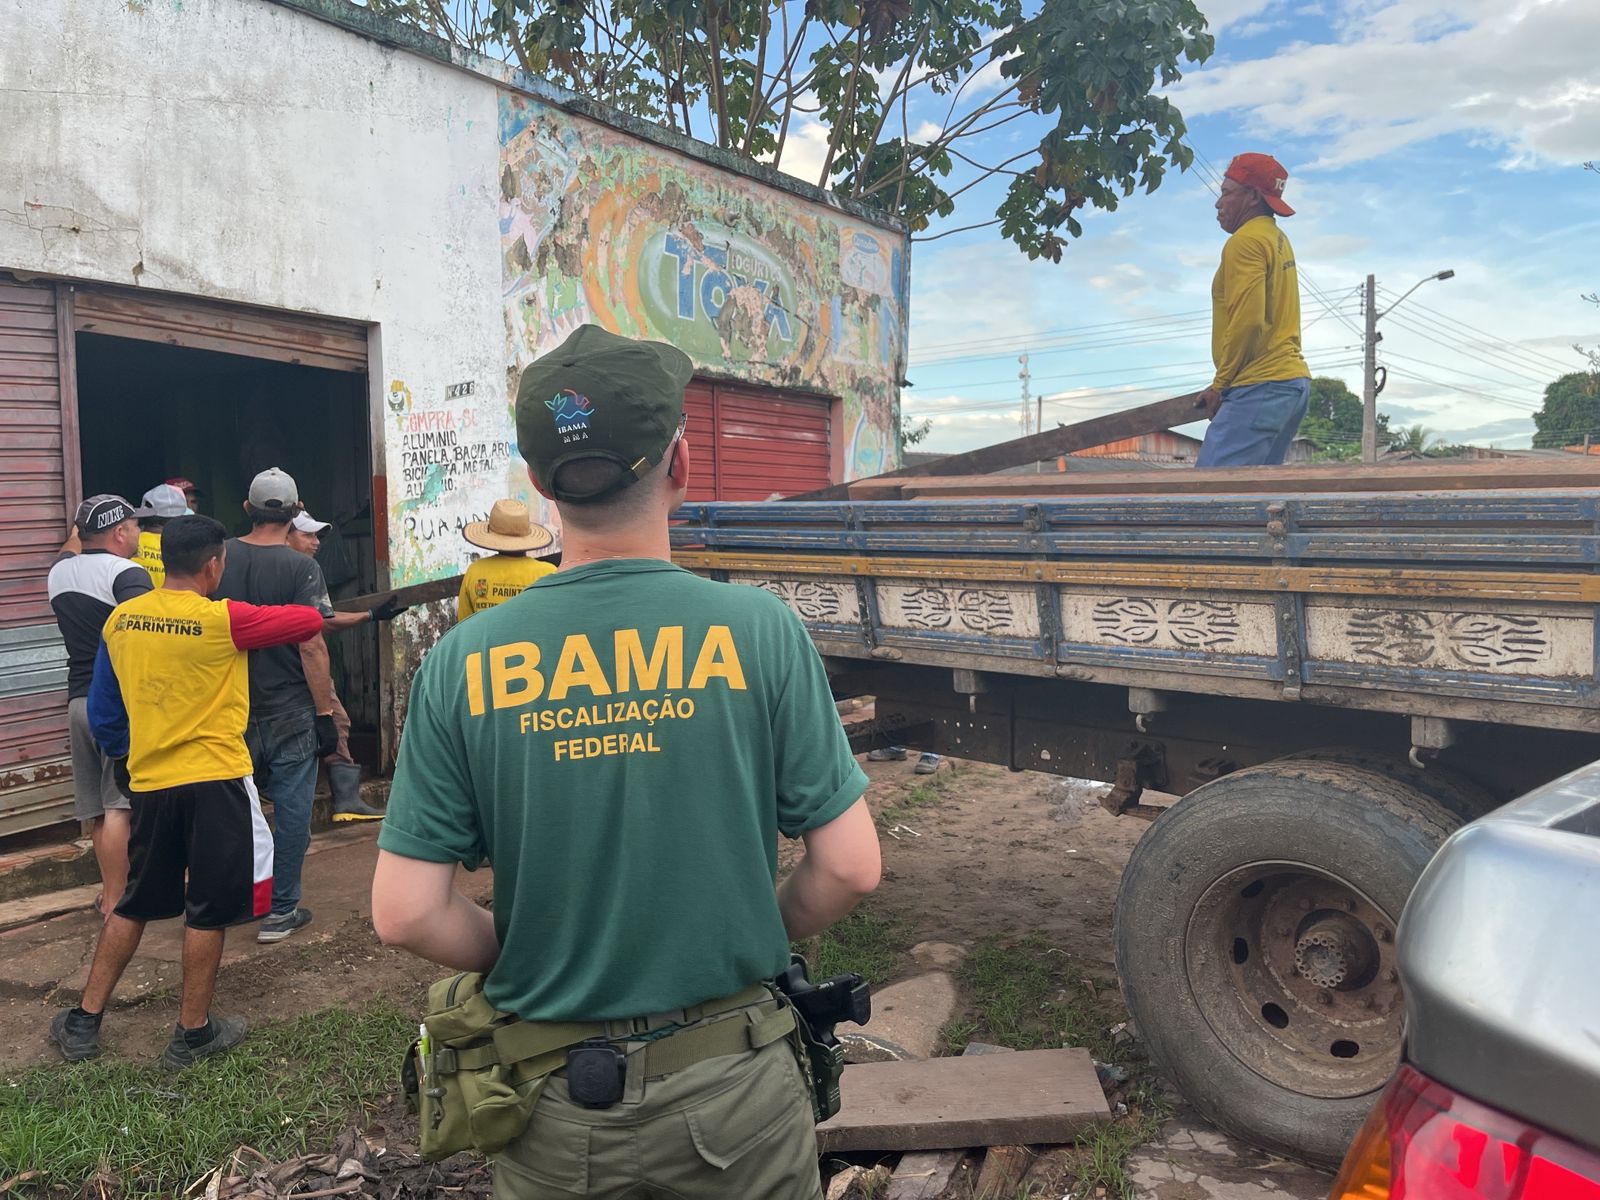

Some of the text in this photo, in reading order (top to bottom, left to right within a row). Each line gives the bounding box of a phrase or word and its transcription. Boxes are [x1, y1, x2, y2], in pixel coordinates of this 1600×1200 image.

[455, 382, 474, 398] 426
[406, 408, 478, 432] OMPRA-SE
[557, 421, 588, 435] IBAMA
[97, 504, 125, 529] NIKE
[492, 587, 523, 598] PARINT
[126, 620, 203, 636] PARINTINS
[128, 614, 202, 626] PREFEITURA MUNICIPAL
[466, 625, 748, 717] IBAMA
[519, 693, 695, 734] FISCALIZAÇÃO
[554, 732, 661, 761] FEDERAL
